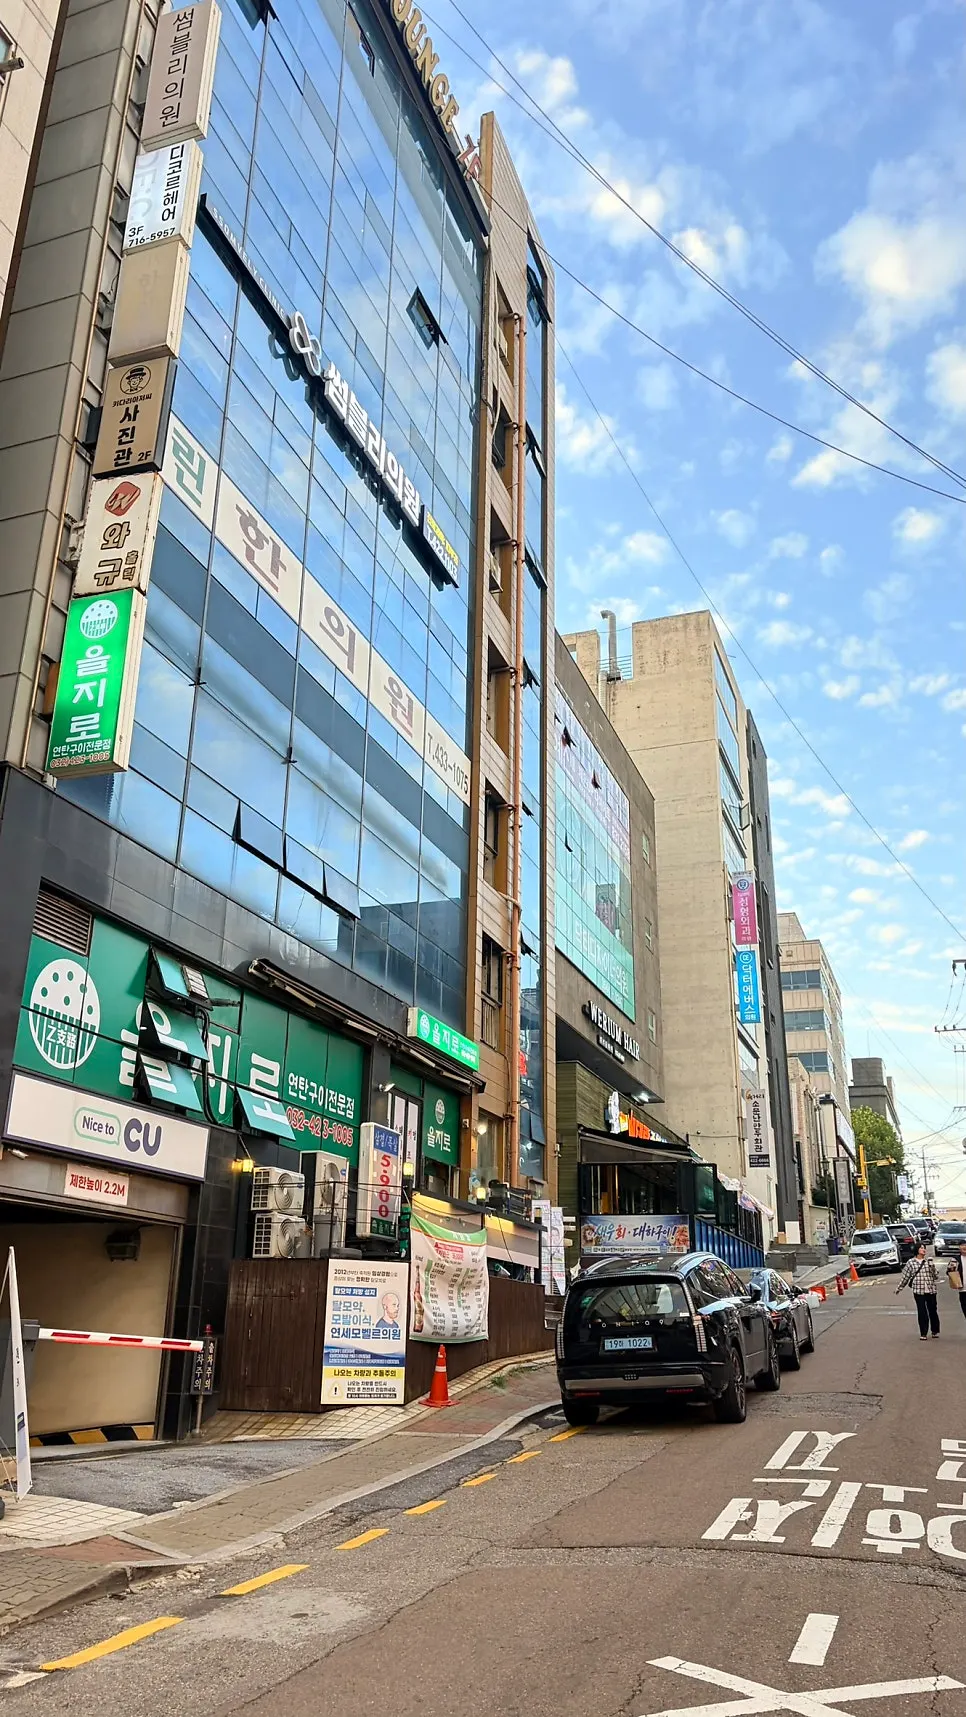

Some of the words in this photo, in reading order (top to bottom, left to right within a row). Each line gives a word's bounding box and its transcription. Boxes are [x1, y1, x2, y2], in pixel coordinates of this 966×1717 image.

[159, 8, 194, 128] 썸블리의원
[161, 144, 185, 221] 디코르헤어
[128, 226, 144, 238] 3F
[128, 227, 175, 248] 716-5957
[113, 404, 139, 467] 사진관
[324, 361, 420, 527] 썸블리의원
[137, 450, 152, 461] 2F
[94, 521, 130, 586] 와규
[66, 645, 111, 743] 을지로
[52, 739, 111, 757] 연탄구이전문점
[623, 1031, 640, 1061] HAIR
[288, 1072, 355, 1120] 연탄구이전문점
[82, 1116, 103, 1133] Nice
[104, 1120, 115, 1136] to
[124, 1117, 162, 1156] CU
[427, 1125, 451, 1152] 을지로
[70, 1174, 103, 1193] 제한높이
[104, 1181, 125, 1197] 2.2M
[331, 1328, 401, 1341] 연세모벨르의원
[628, 1338, 648, 1347] 1022
[194, 1349, 204, 1390] 차주의
[205, 1342, 215, 1390] 출차주의
